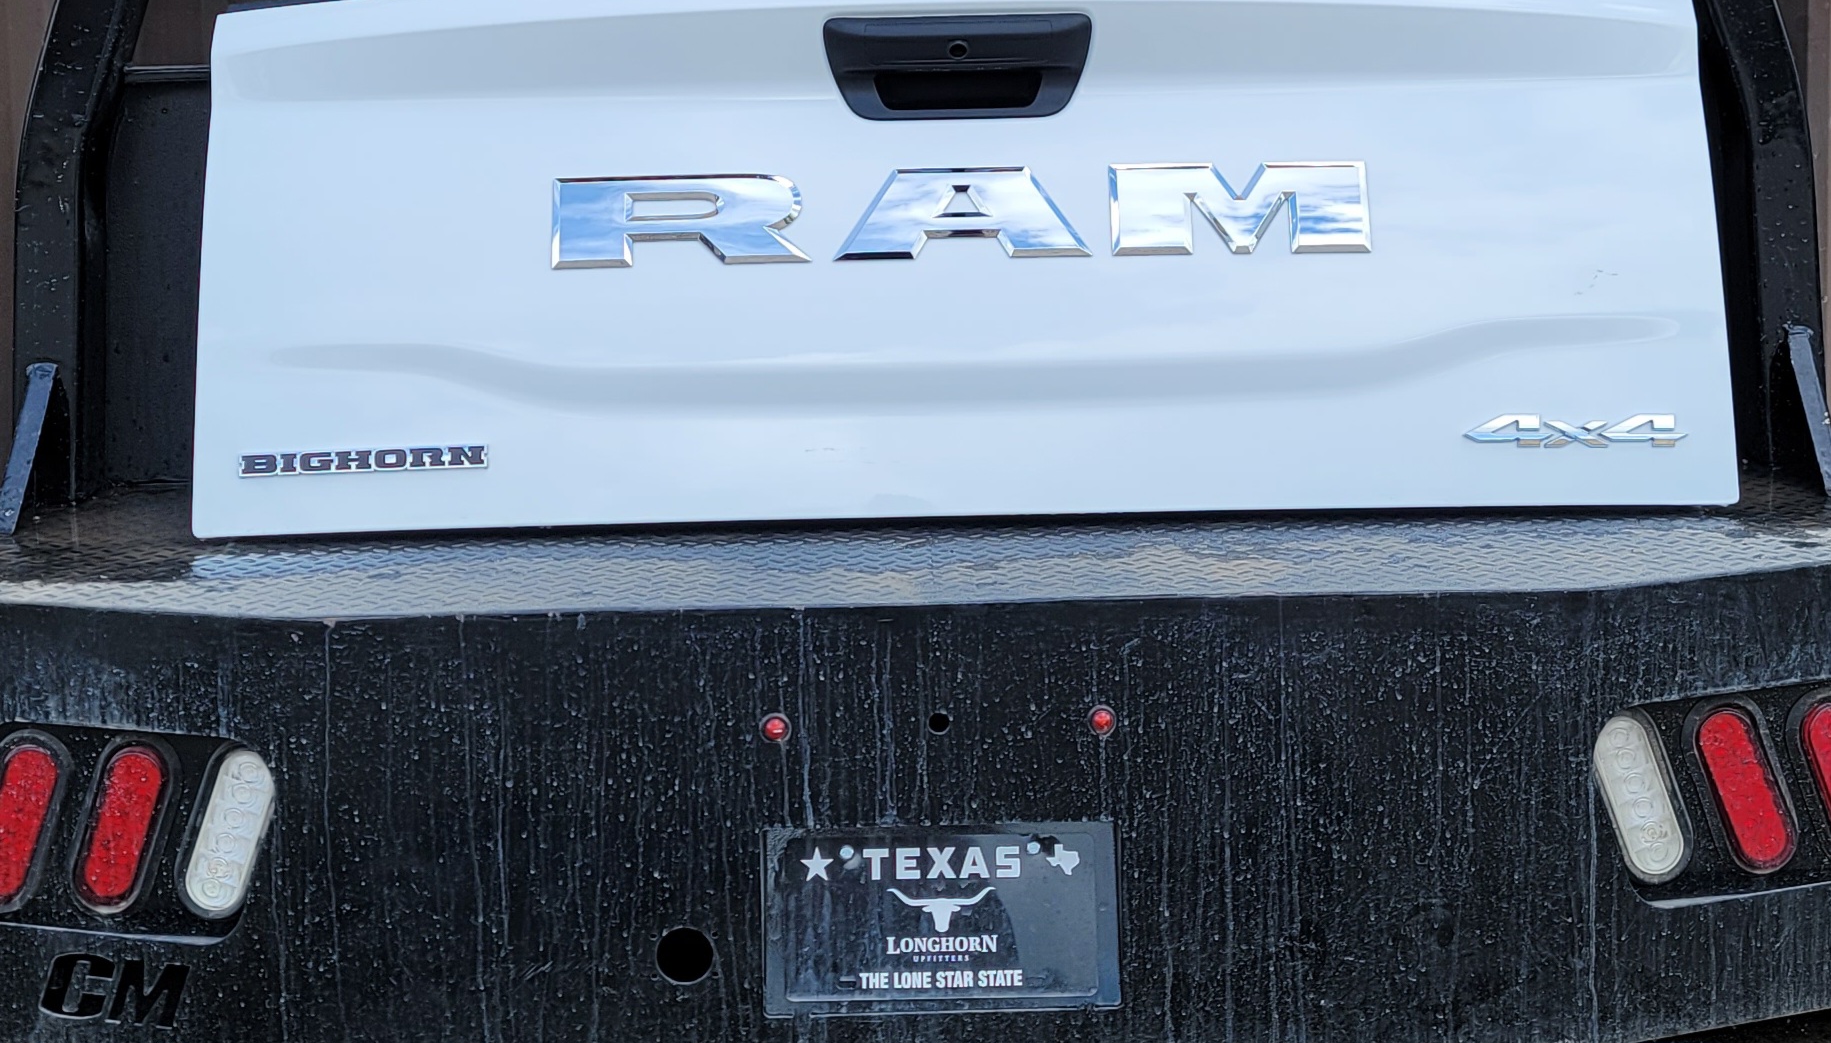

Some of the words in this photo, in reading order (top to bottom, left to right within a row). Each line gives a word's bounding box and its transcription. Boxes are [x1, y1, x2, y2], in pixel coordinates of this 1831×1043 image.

[551, 160, 1372, 270] RAM
[238, 444, 488, 477] BIGHORN
[863, 845, 1021, 881] TEXAS
[886, 934, 999, 955] LONGHORN
[38, 952, 191, 1029] CM
[859, 971, 889, 989] THE
[893, 970, 932, 989] LONE
[935, 969, 974, 988] STAR
[977, 969, 1023, 987] STATE
